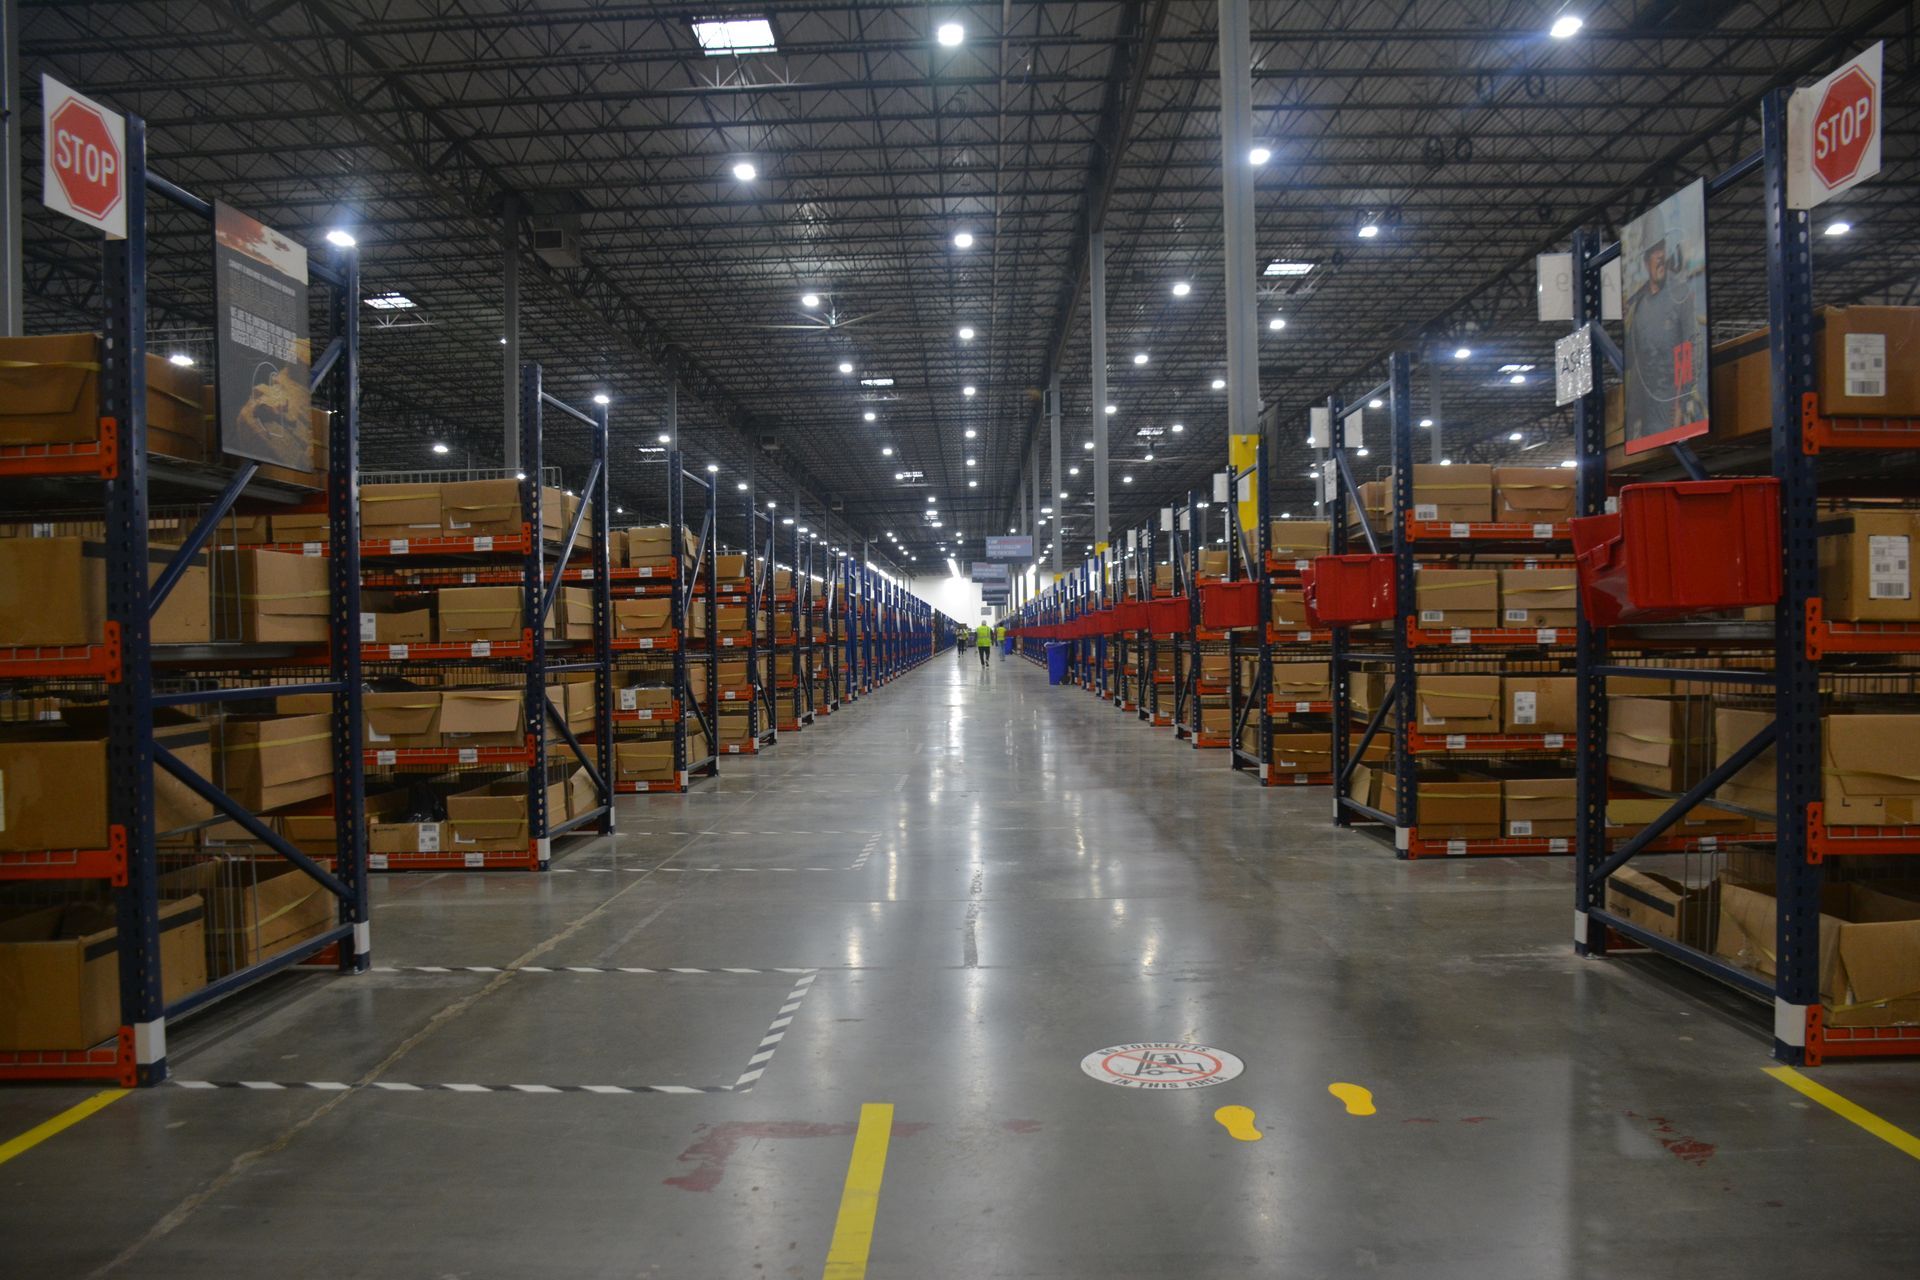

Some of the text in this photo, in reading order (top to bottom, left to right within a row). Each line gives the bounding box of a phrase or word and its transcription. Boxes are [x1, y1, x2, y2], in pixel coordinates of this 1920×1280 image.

[1816, 97, 1869, 159] STOP
[57, 129, 115, 187] STOP
[1097, 1042, 1210, 1056] NO FORKLIFTS
[1112, 1075, 1228, 1089] IN THIS AREA
